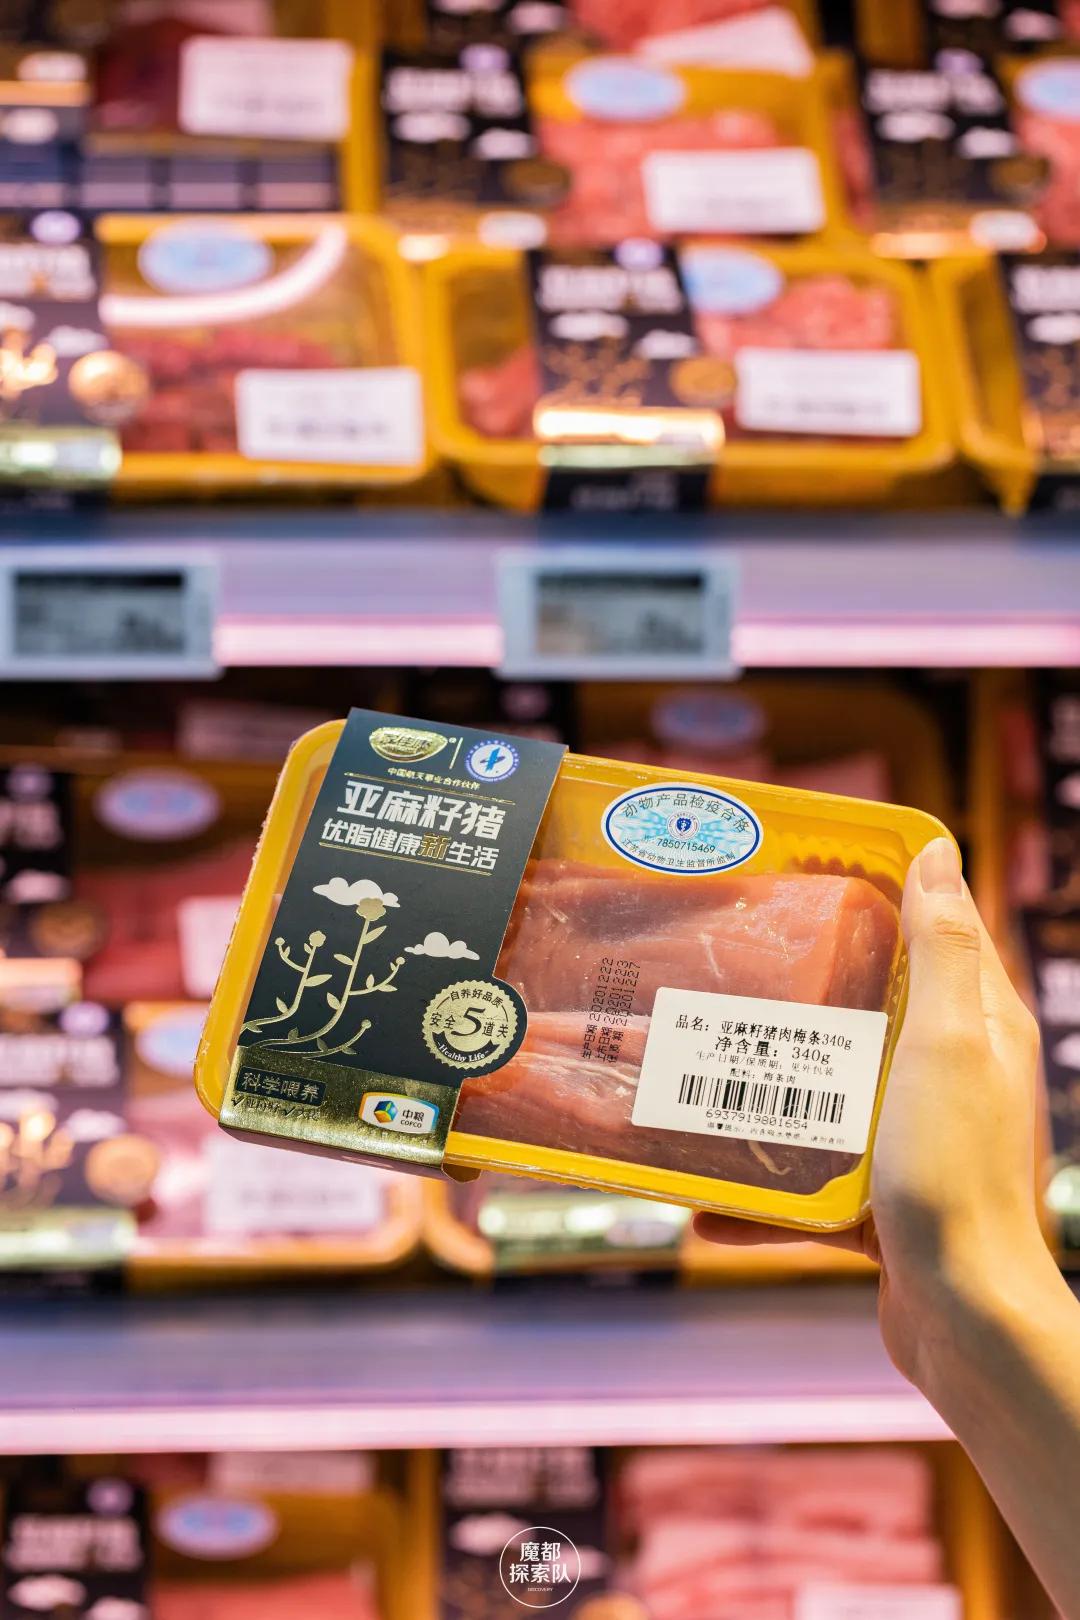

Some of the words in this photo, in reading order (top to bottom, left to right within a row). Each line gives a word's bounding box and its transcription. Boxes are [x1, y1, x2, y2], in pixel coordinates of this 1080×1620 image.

[336, 780, 506, 840] 亚麻籽猪
[622, 793, 750, 834] 动物产品检疫合格
[321, 817, 499, 870] 优脂健康新生活
[656, 838, 716, 854] 7850715469
[450, 988, 504, 1008] 自养好品质
[589, 957, 614, 1022] 20201222
[438, 1043, 467, 1062] Healthy
[468, 1052, 486, 1062] Life
[240, 1071, 320, 1103] 科学喂养
[400, 1120, 422, 1129] COFCO
[402, 1110, 425, 1122] 中粮
[705, 1108, 808, 1130] 6937919801654
